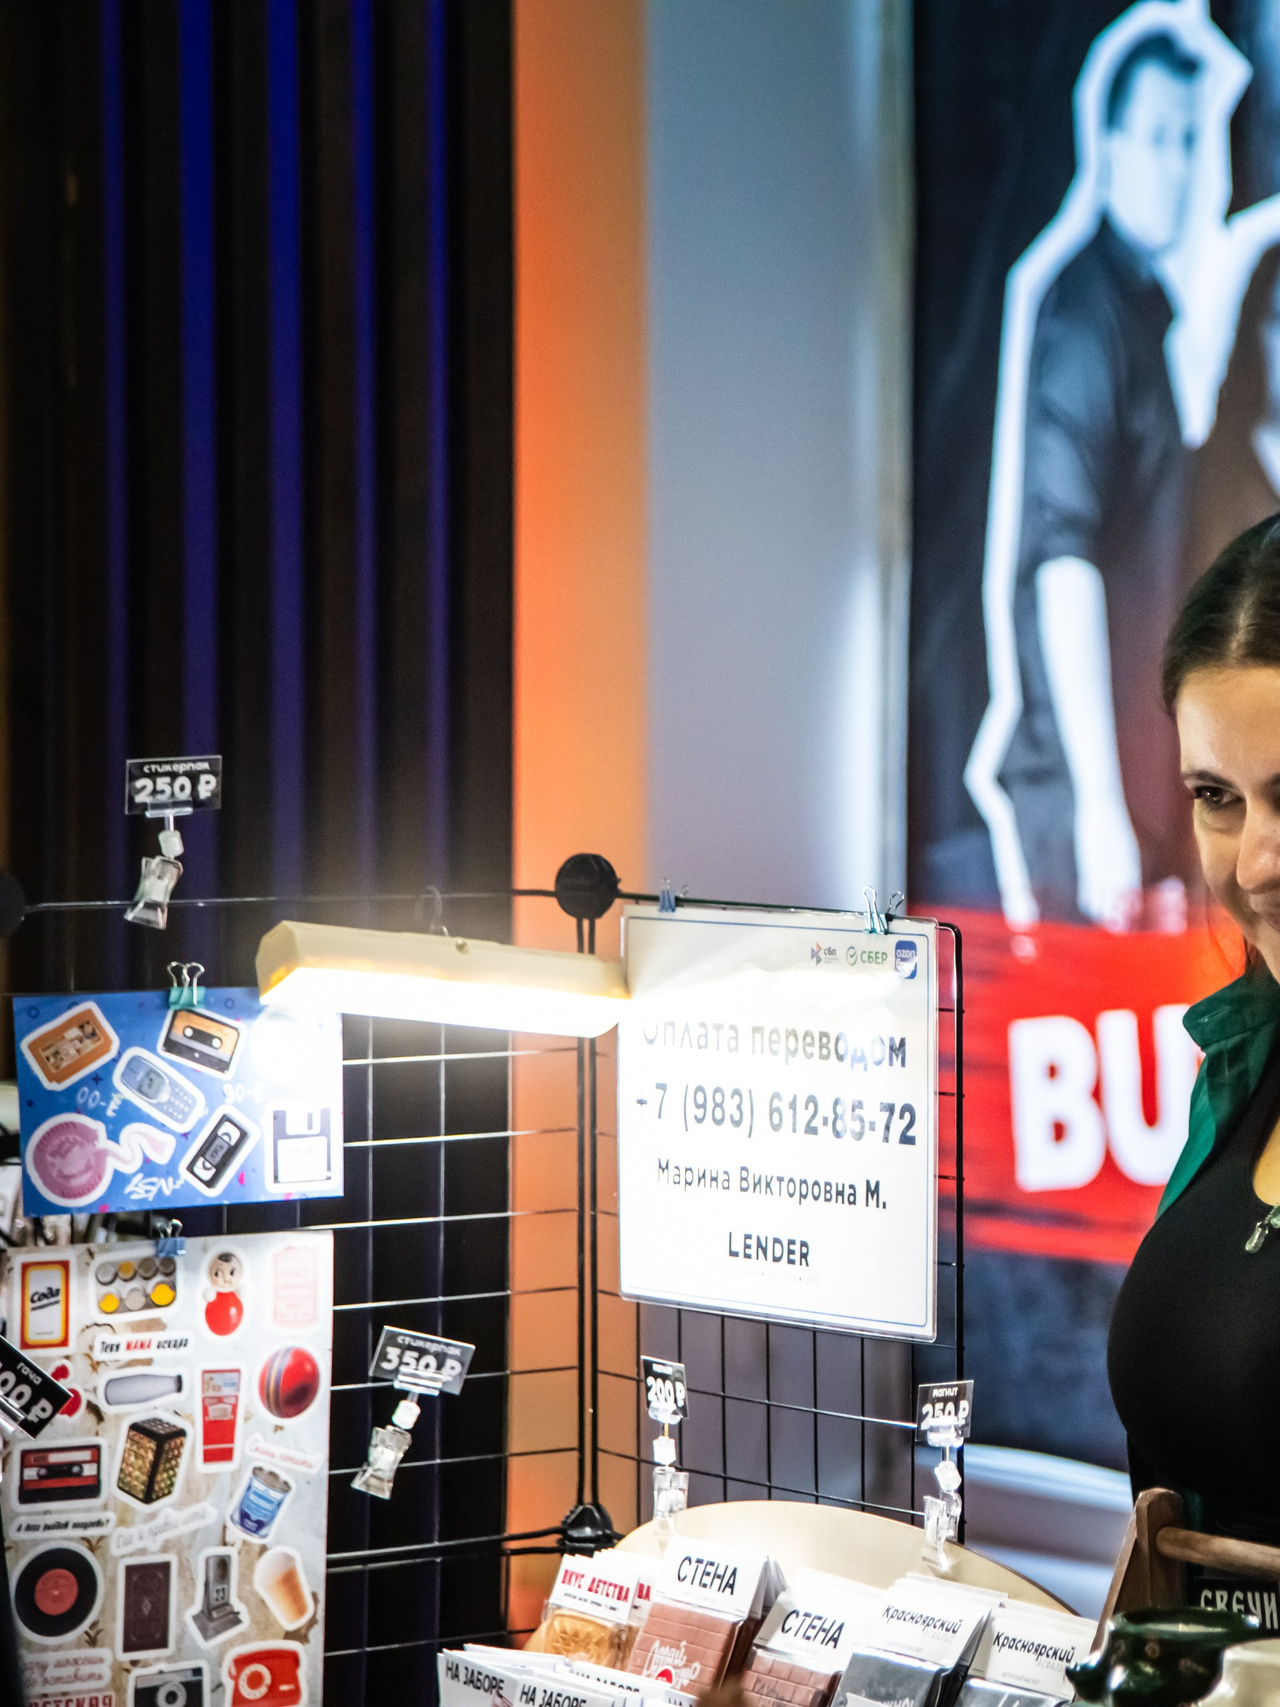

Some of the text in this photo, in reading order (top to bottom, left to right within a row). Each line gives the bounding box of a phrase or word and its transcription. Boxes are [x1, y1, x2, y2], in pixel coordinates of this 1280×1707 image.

[143, 762, 210, 774] стикерпак
[861, 951, 888, 965] СБЕР
[752, 1025, 906, 1072] переводом
[683, 1084, 754, 1138] (983)
[769, 1091, 916, 1146] 612-85-72
[658, 1158, 887, 1209] Марина Викторовна М.
[728, 1231, 810, 1267] LENDER
[587, 1577, 630, 1602] ДЕТСТВА
[678, 1555, 737, 1595] СТЕНА
[781, 1609, 845, 1649] СТЕНА
[882, 1604, 963, 1634] Красноярский
[993, 1631, 1076, 1664] Красноярский
[446, 1660, 505, 1698] НА ЗАБОРЕ
[519, 1684, 537, 1706] НА
